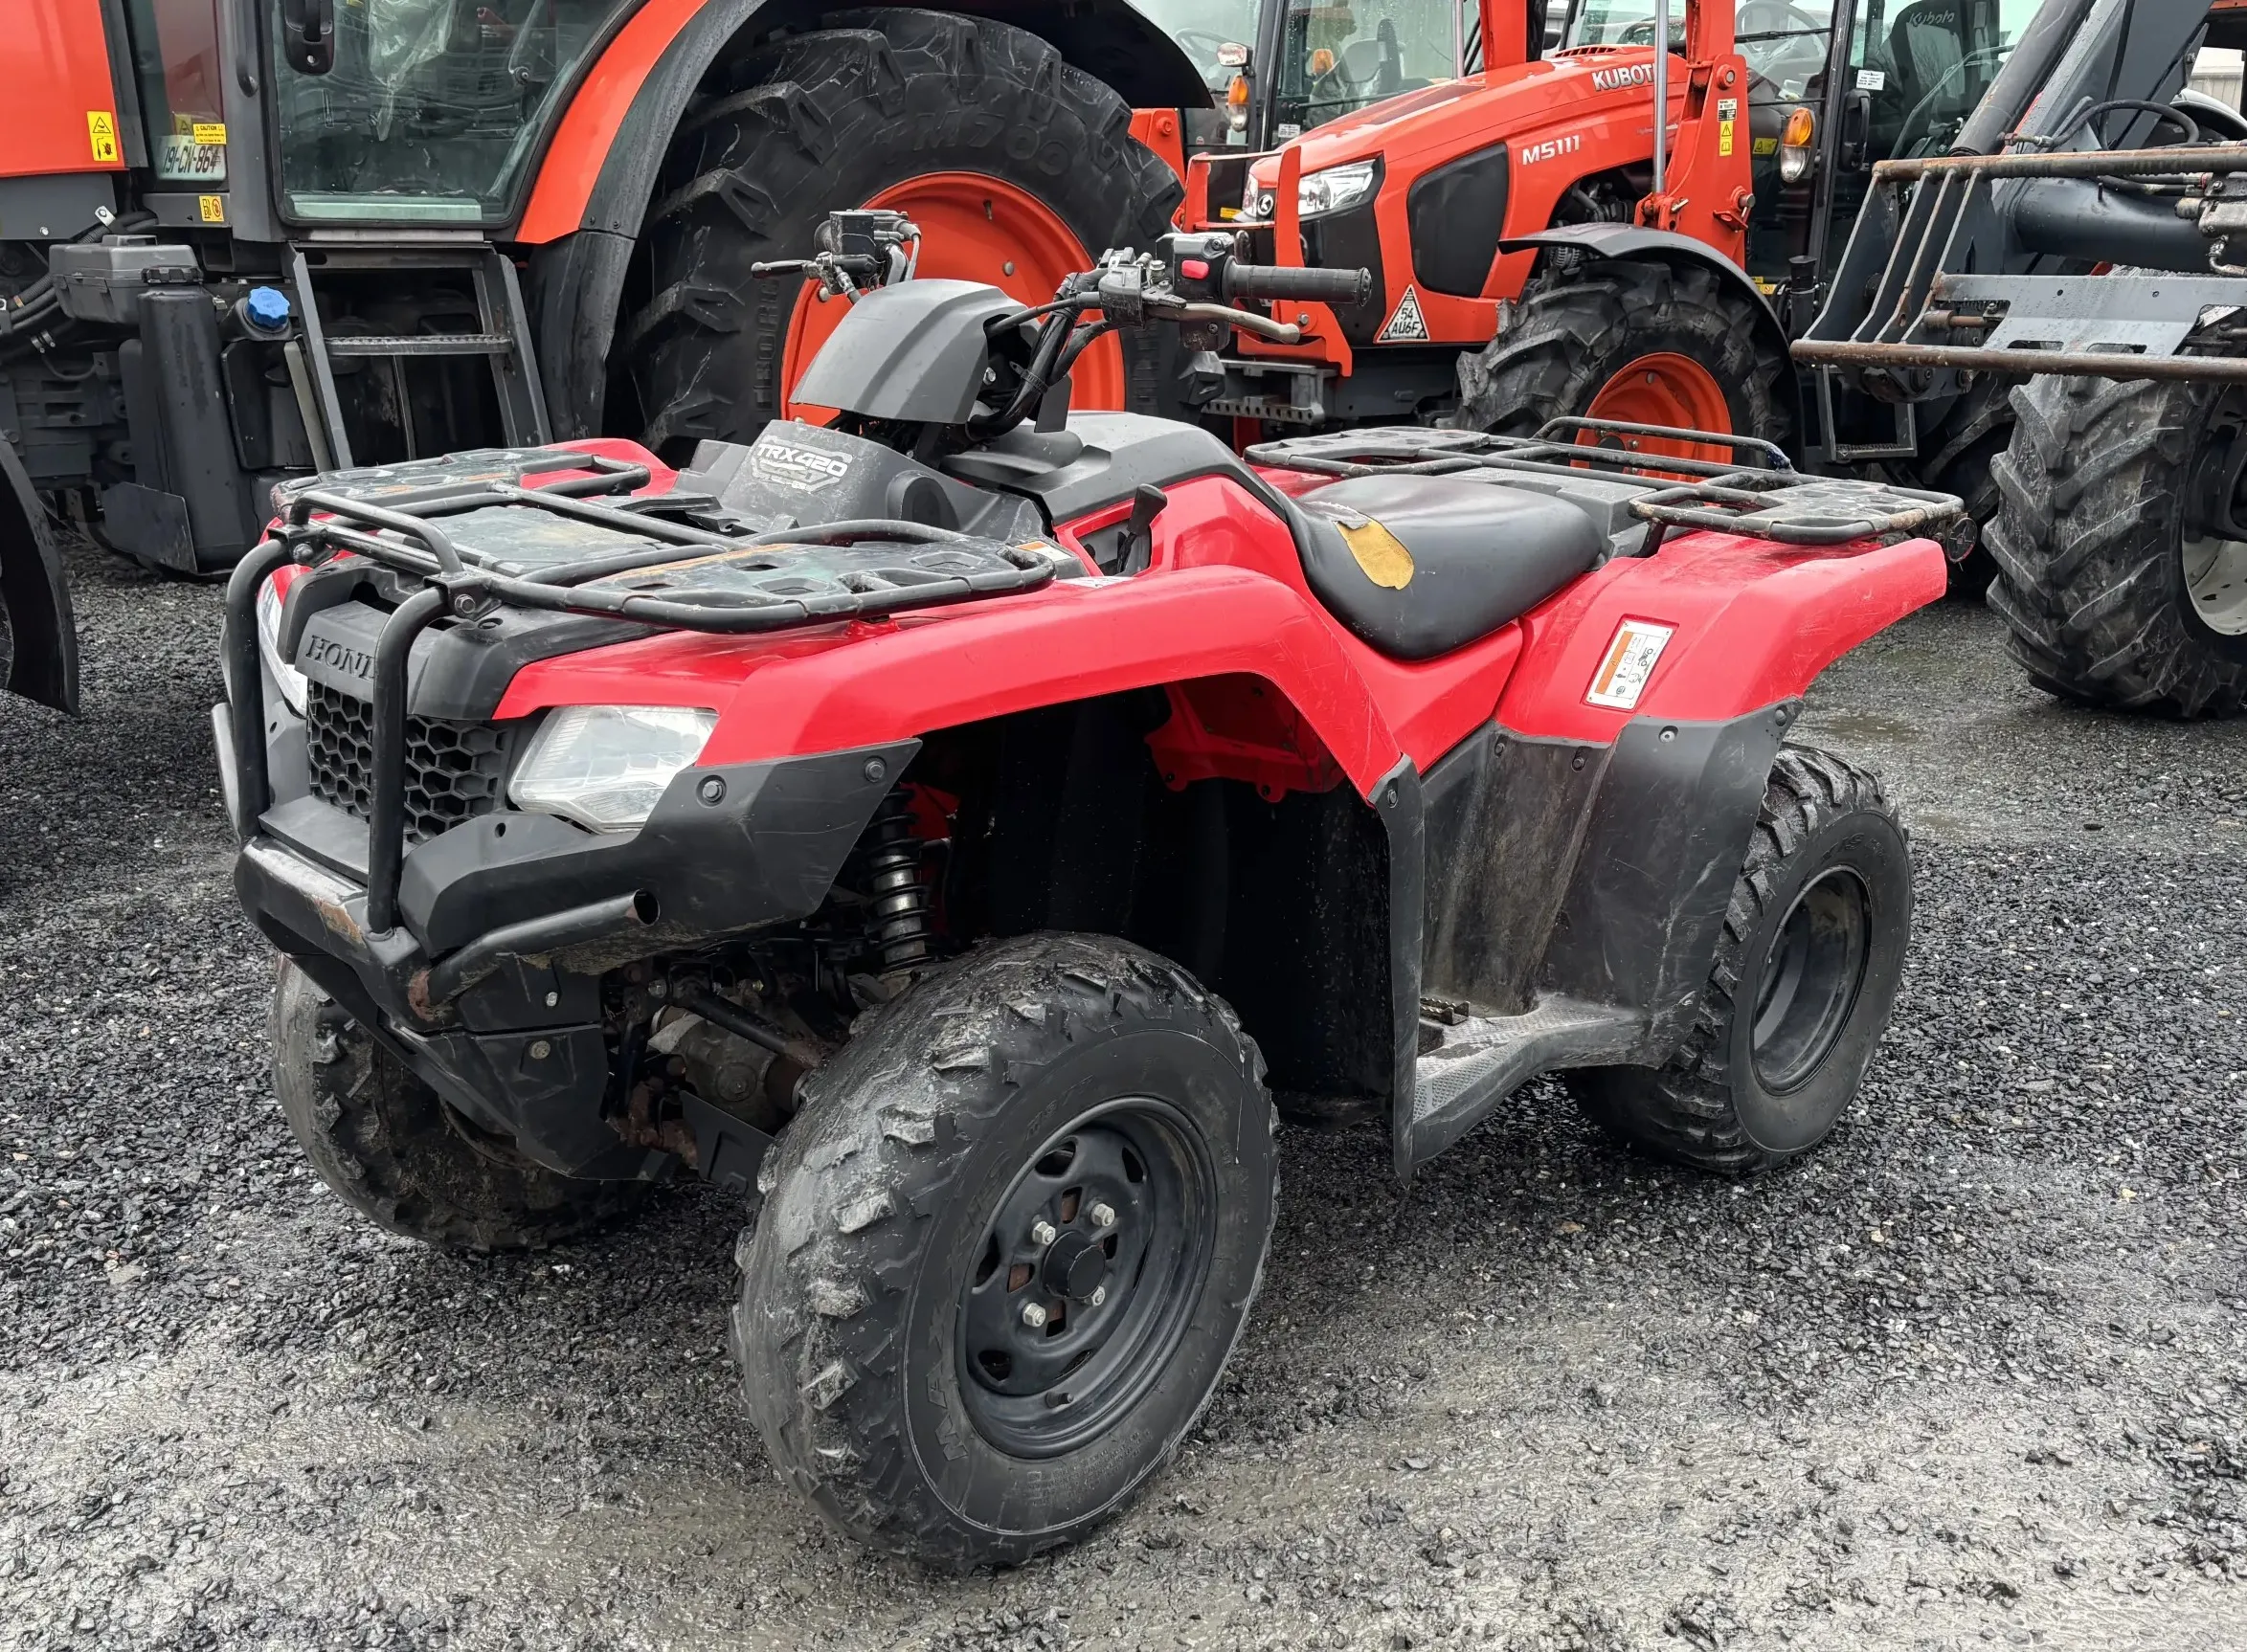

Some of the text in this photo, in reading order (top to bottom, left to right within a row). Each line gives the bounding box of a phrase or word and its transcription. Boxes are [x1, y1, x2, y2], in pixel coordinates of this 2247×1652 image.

[1908, 10, 1955, 27] Kubota
[1591, 63, 1655, 92] KUBOT
[1522, 135, 1581, 166] M5111
[756, 442, 848, 478] TRX420
[304, 635, 375, 681] HOND
